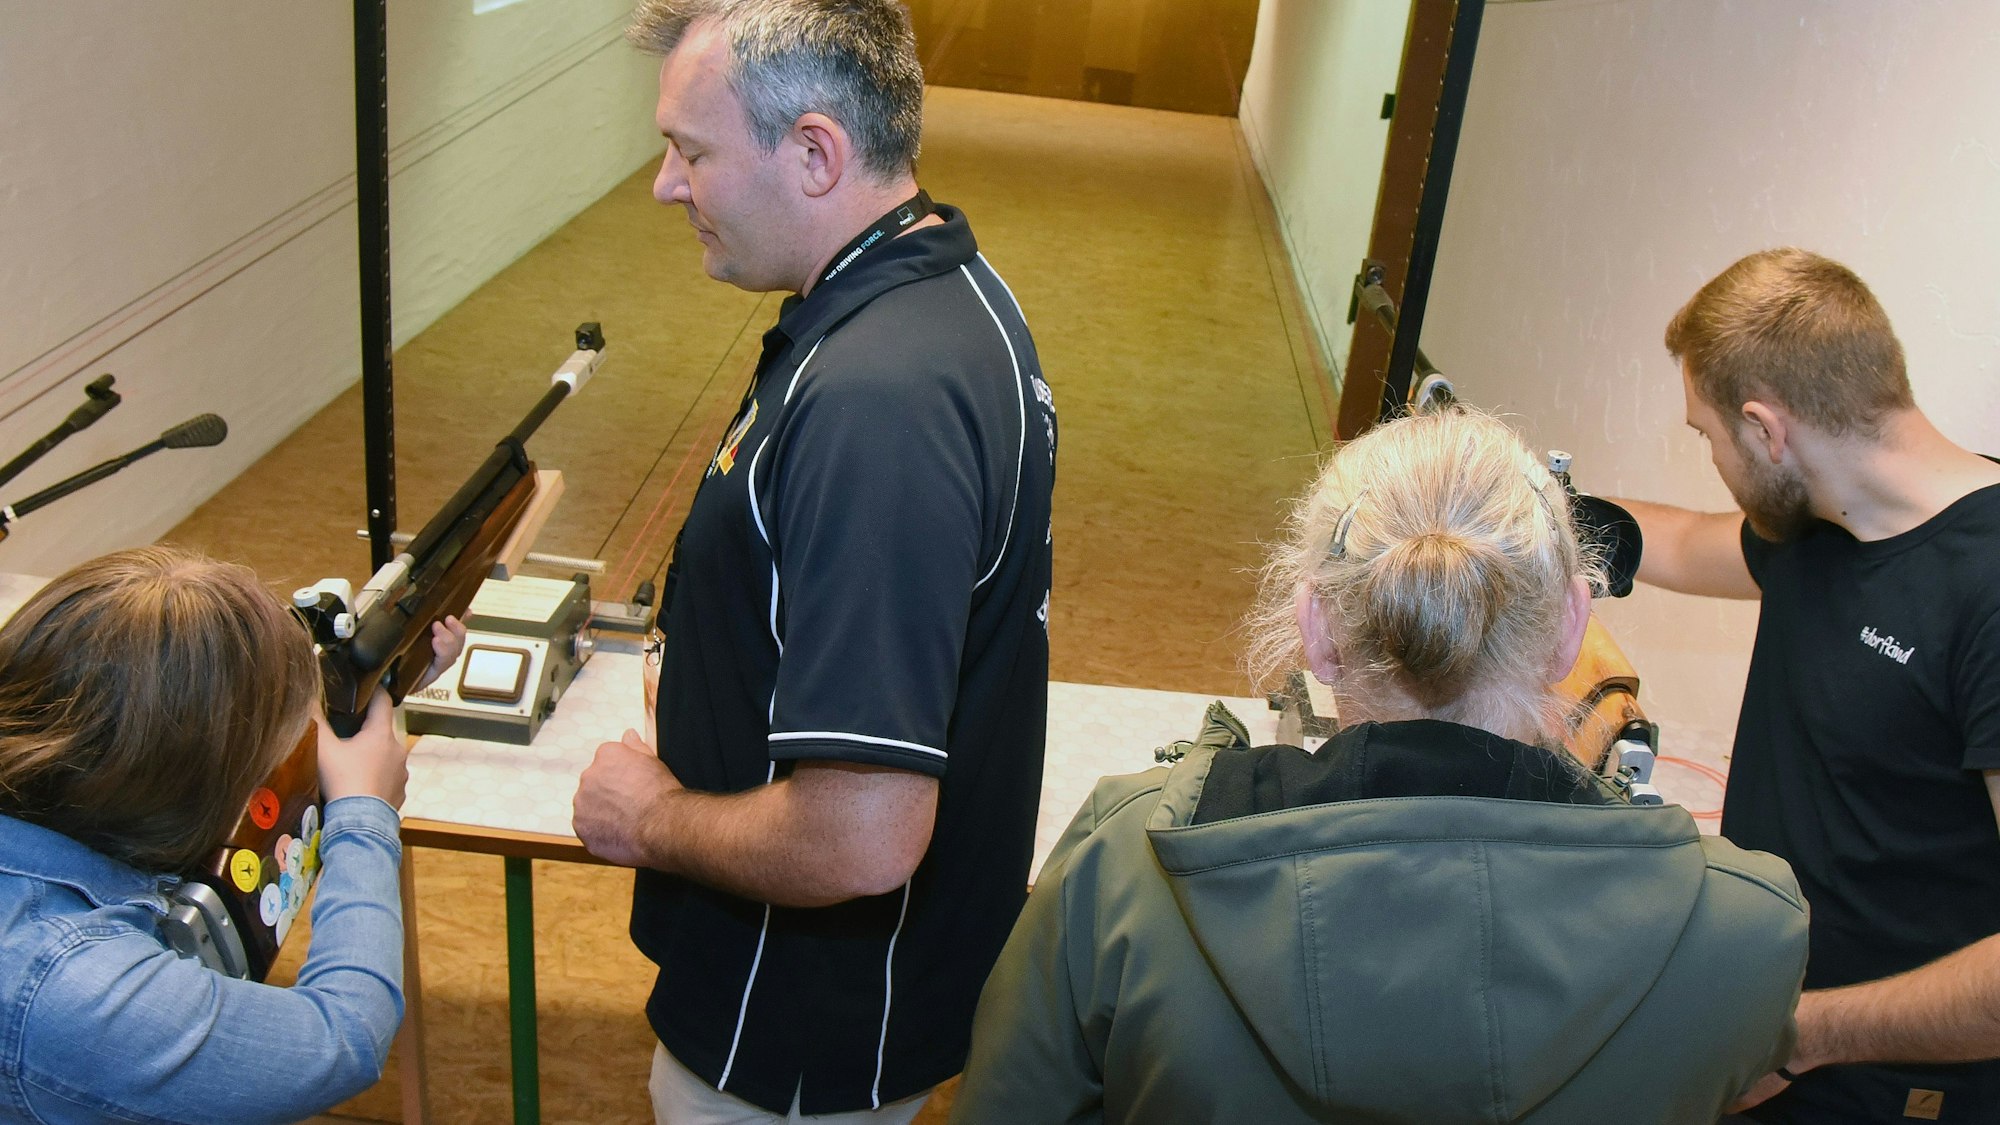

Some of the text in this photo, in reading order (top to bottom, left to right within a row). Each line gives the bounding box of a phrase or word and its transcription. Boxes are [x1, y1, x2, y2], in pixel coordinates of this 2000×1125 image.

[835, 246, 864, 272] DRIVING
[860, 229, 886, 250] FORCE.
[1859, 625, 1916, 665] #dorfkind
